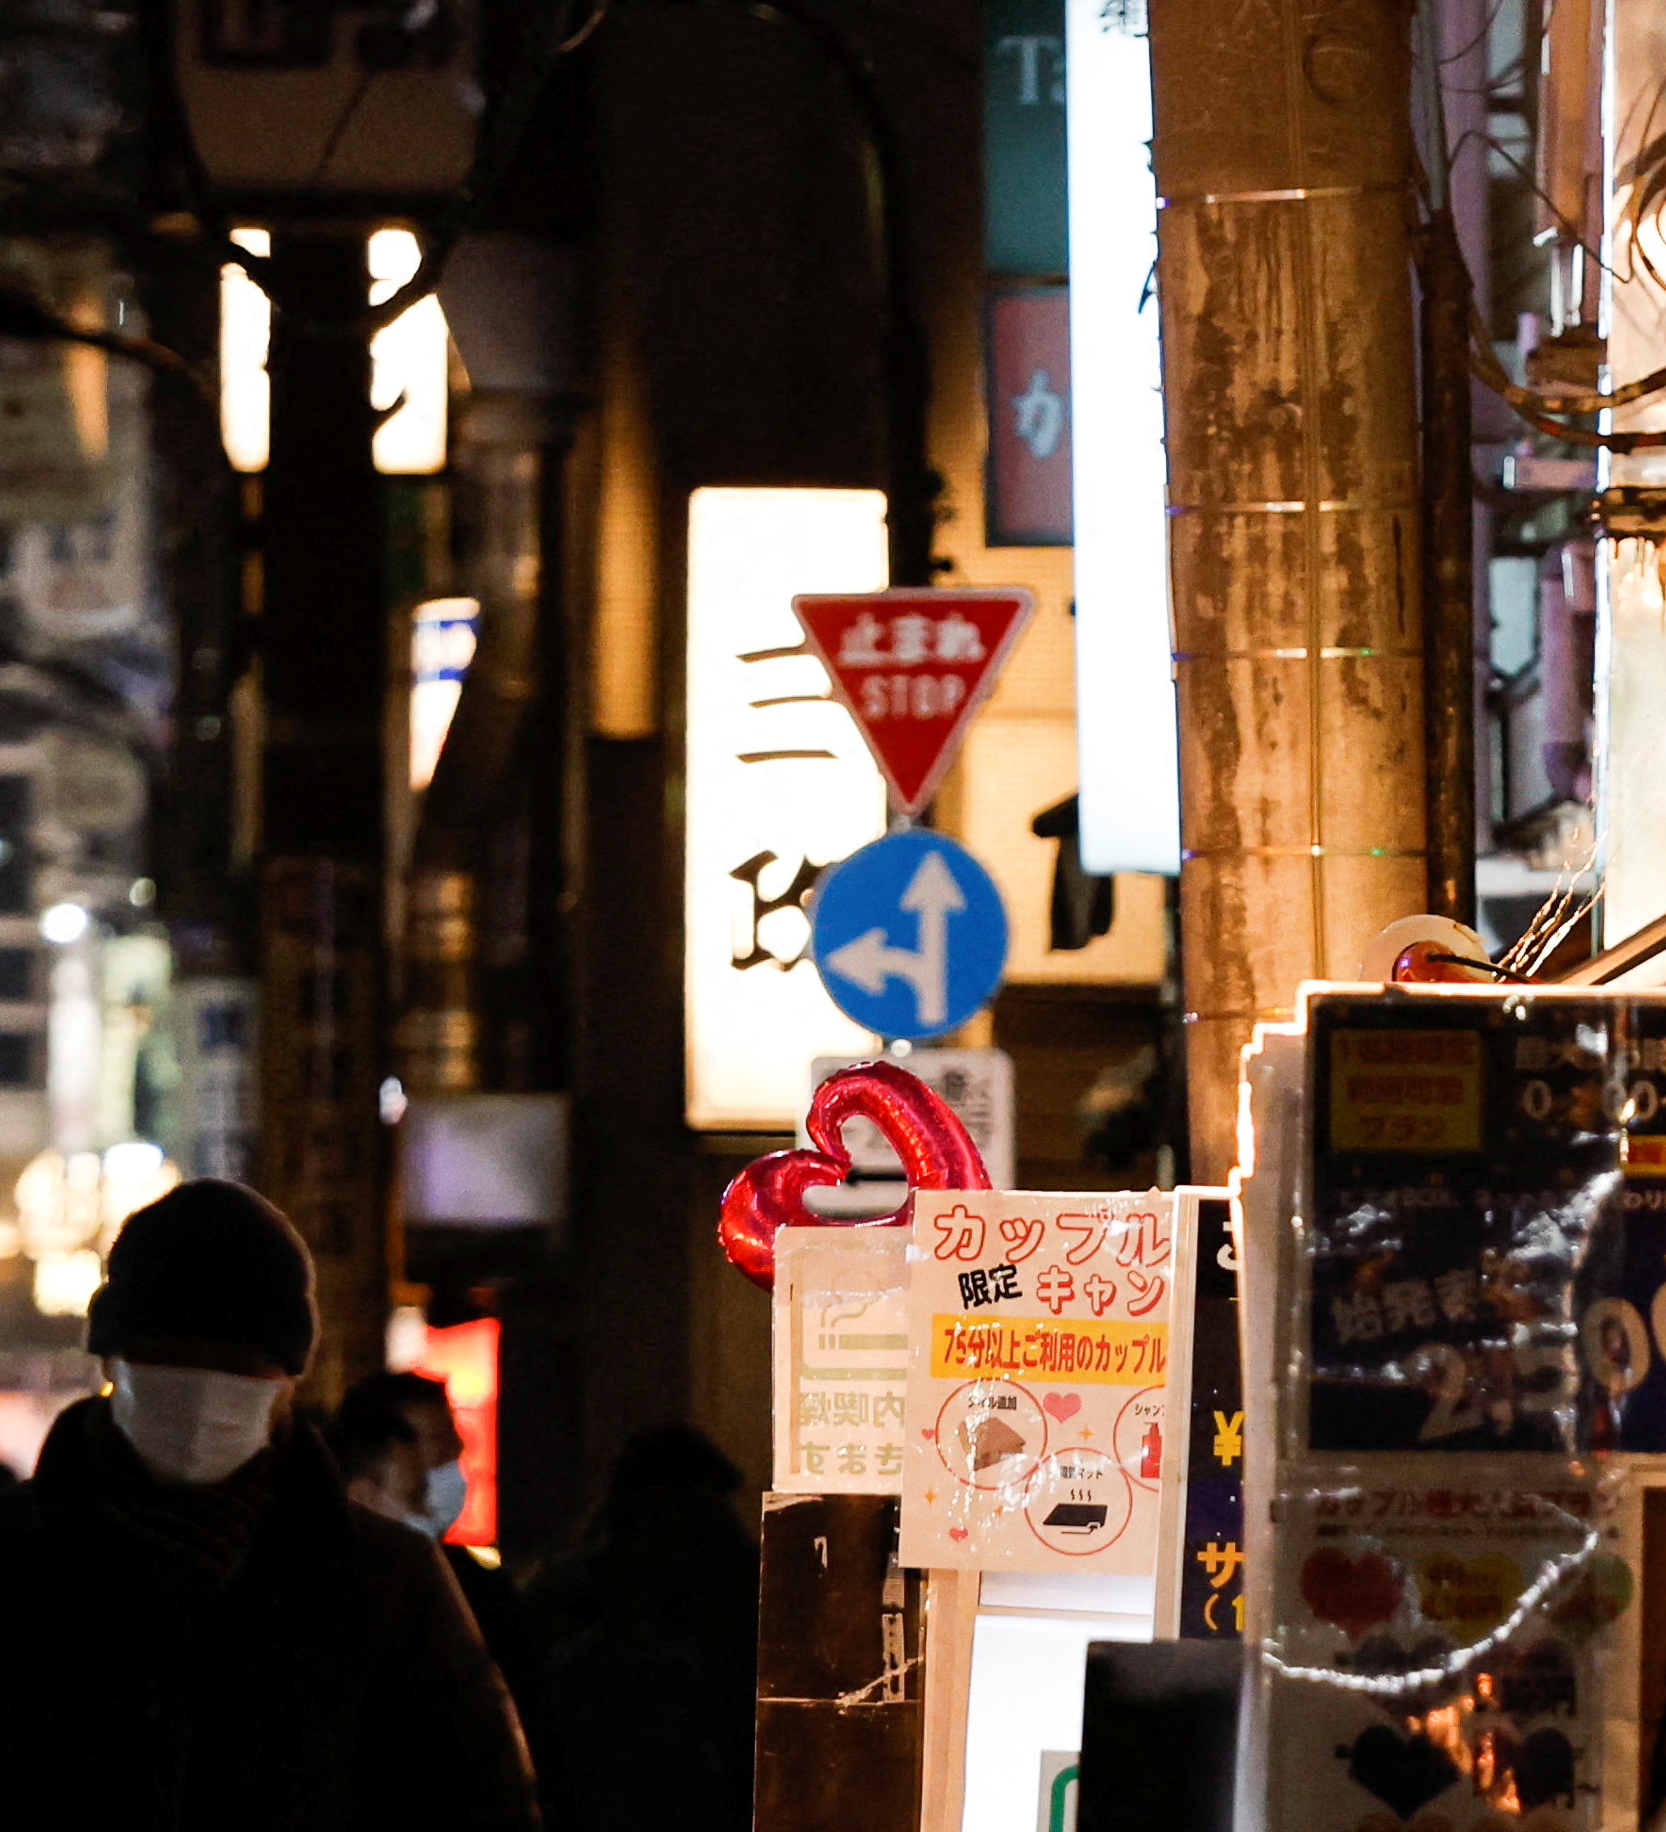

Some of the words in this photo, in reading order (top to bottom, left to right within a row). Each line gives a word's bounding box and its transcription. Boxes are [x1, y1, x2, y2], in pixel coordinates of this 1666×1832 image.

[838, 611, 986, 666] 止まれ
[863, 673, 965, 719] STOP
[934, 1204, 1171, 1268] カップル
[957, 1263, 1023, 1310] 限定
